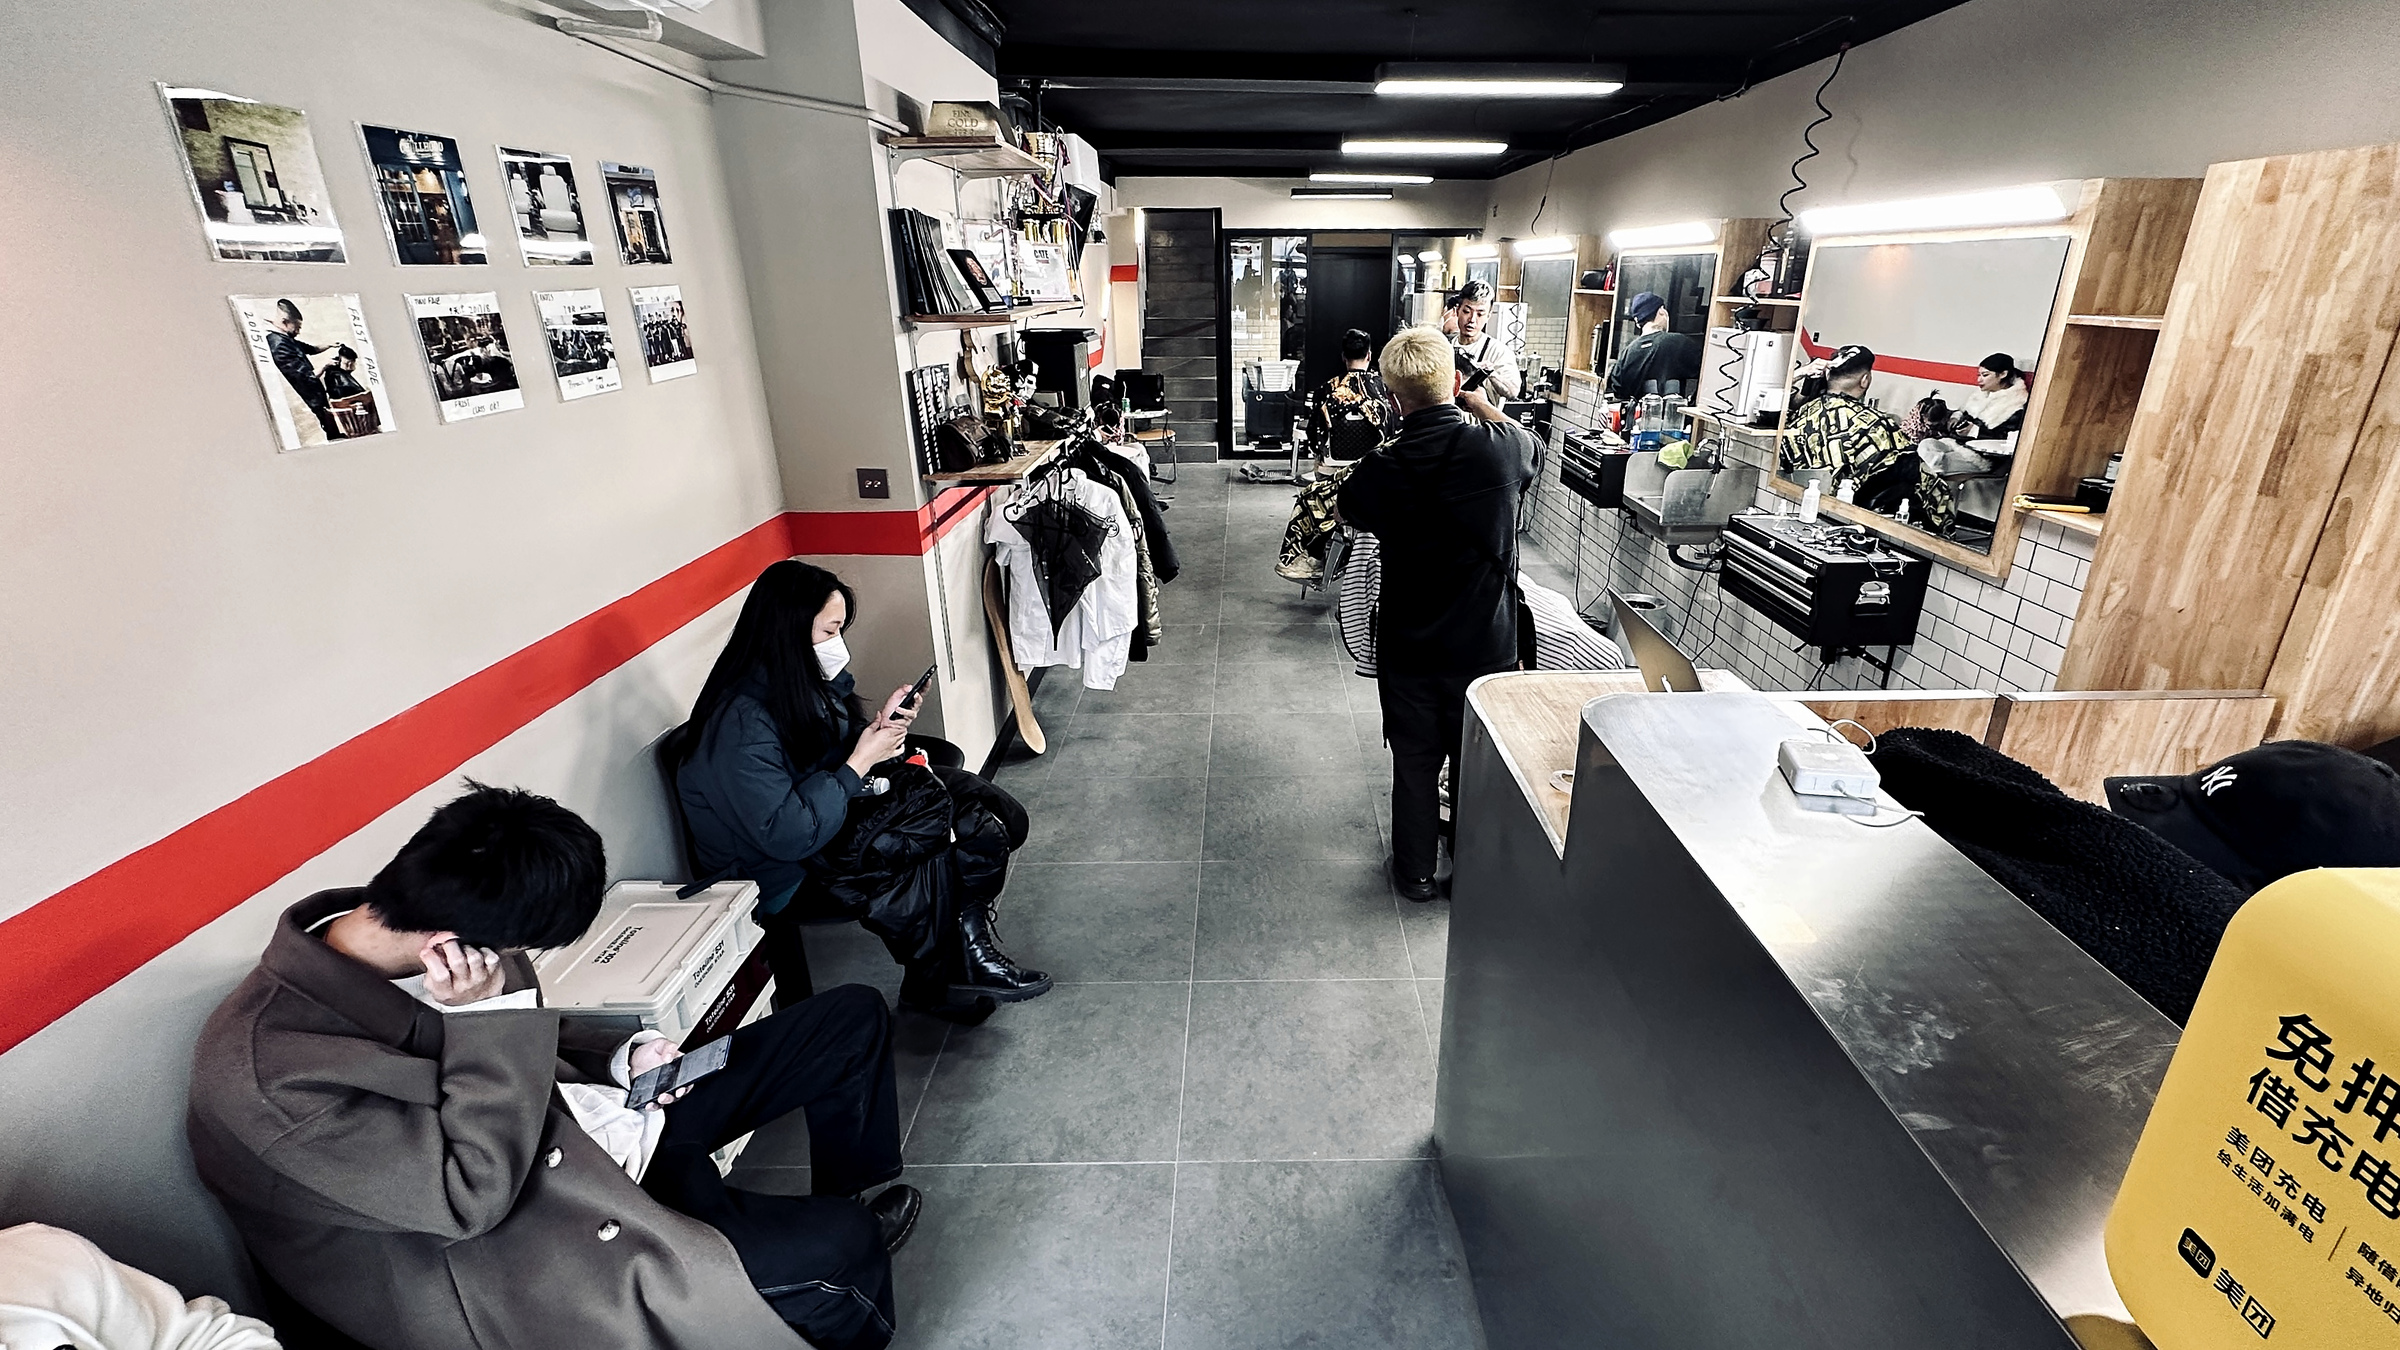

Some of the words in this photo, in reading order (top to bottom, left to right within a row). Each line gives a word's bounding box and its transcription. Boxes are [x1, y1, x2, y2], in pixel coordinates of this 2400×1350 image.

[947, 118, 979, 128] GOLD
[243, 311, 270, 364] 2015/11
[347, 306, 369, 344] FRIST
[364, 356, 381, 386] FADE
[2200, 765, 2238, 797] NY
[2264, 1013, 2400, 1144] 免押
[2225, 1126, 2327, 1224] 美团充电
[2246, 1066, 2400, 1220] 借充电
[2216, 1148, 2315, 1244] 给生活加满电
[2212, 1267, 2277, 1339] 美团
[2356, 1241, 2400, 1290] 随借
